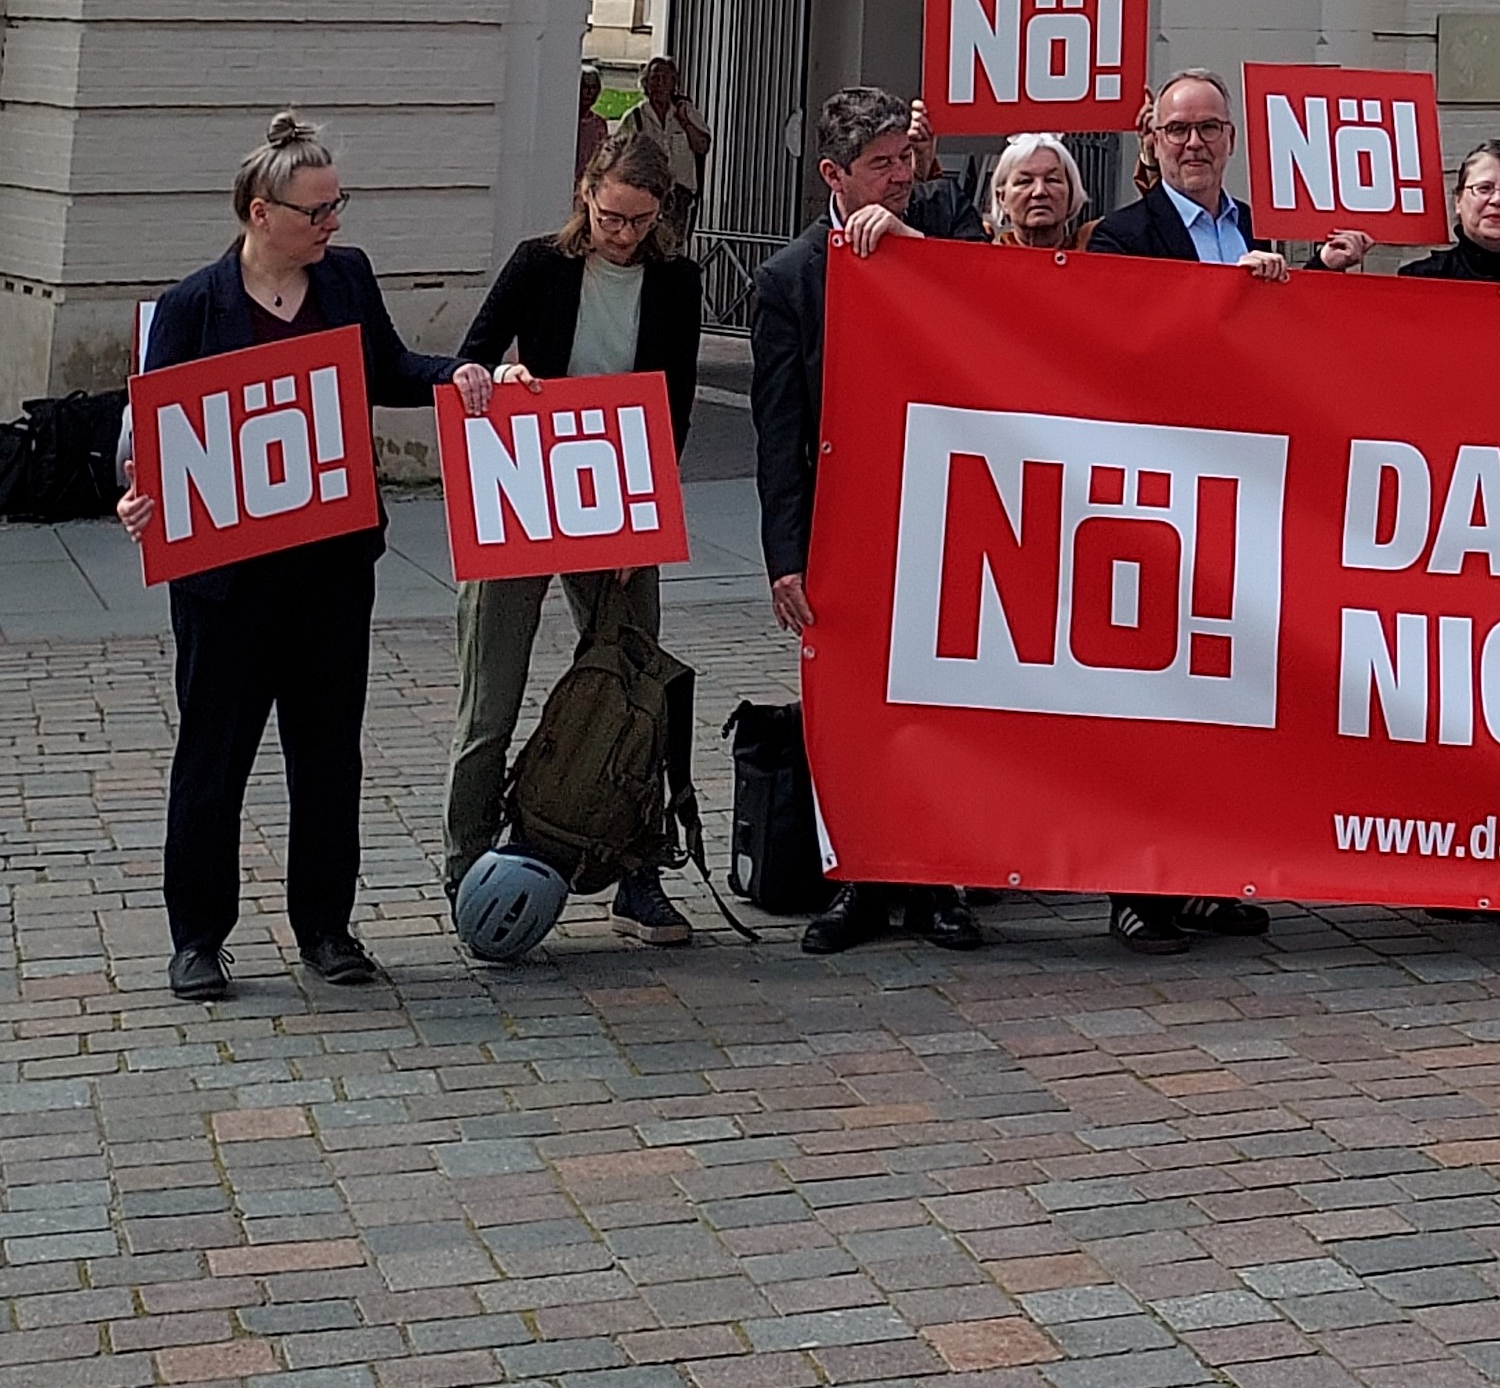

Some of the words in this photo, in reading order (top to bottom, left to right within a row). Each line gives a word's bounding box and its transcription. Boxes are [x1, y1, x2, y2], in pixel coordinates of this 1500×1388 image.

[1265, 93, 1426, 215] NÖ!
[156, 365, 350, 543] NÖ!
[463, 405, 660, 546] NÖ!
[936, 452, 1240, 678] NÖ!
